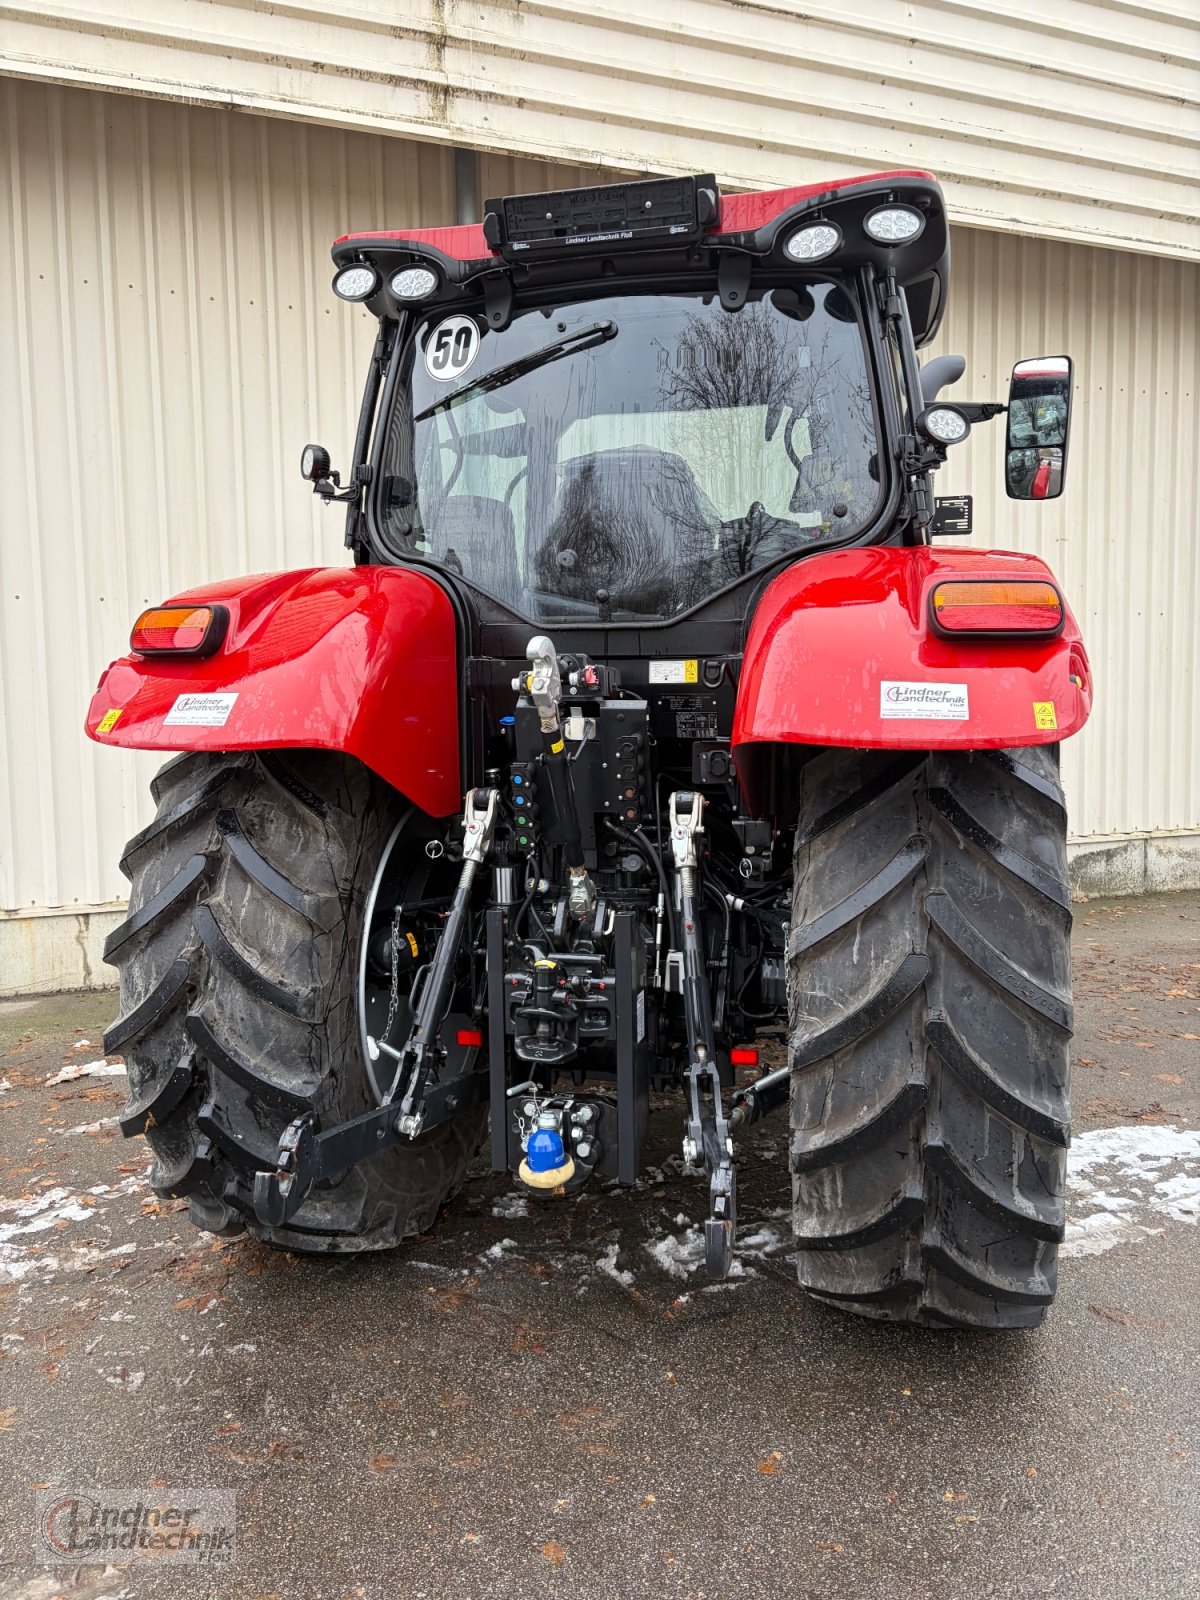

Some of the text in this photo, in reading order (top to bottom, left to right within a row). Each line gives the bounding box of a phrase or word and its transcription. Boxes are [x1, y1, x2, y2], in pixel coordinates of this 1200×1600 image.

[432, 326, 473, 370] 50
[895, 687, 951, 697] Lindner
[895, 694, 966, 703] Landtechnik
